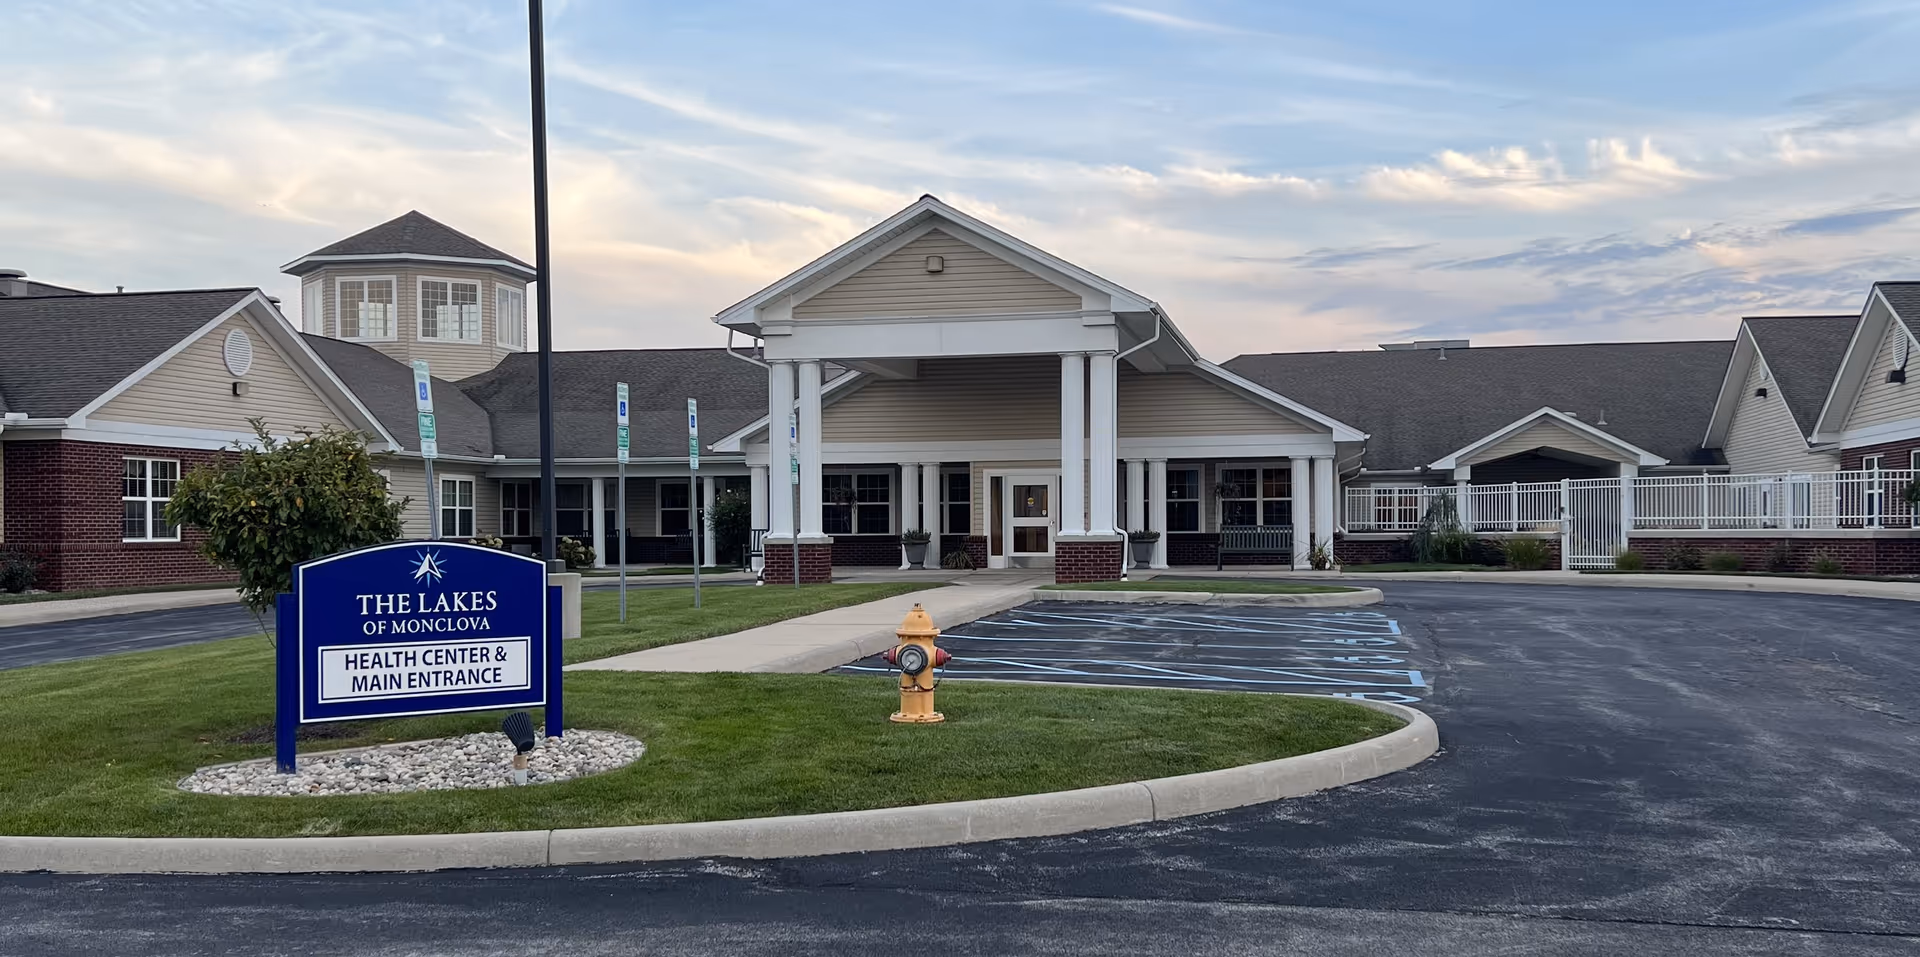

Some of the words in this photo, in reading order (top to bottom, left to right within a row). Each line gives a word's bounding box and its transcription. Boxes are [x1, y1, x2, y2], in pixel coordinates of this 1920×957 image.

[356, 593, 411, 615] THE
[418, 590, 497, 613] LAKES
[363, 620, 387, 635] OF
[391, 616, 490, 634] MONCLOVA
[345, 650, 417, 671] HEALTH
[422, 646, 490, 666] CENTER
[494, 646, 507, 662] &
[352, 673, 402, 693] MAIN
[408, 667, 502, 689] ENTRANCE
